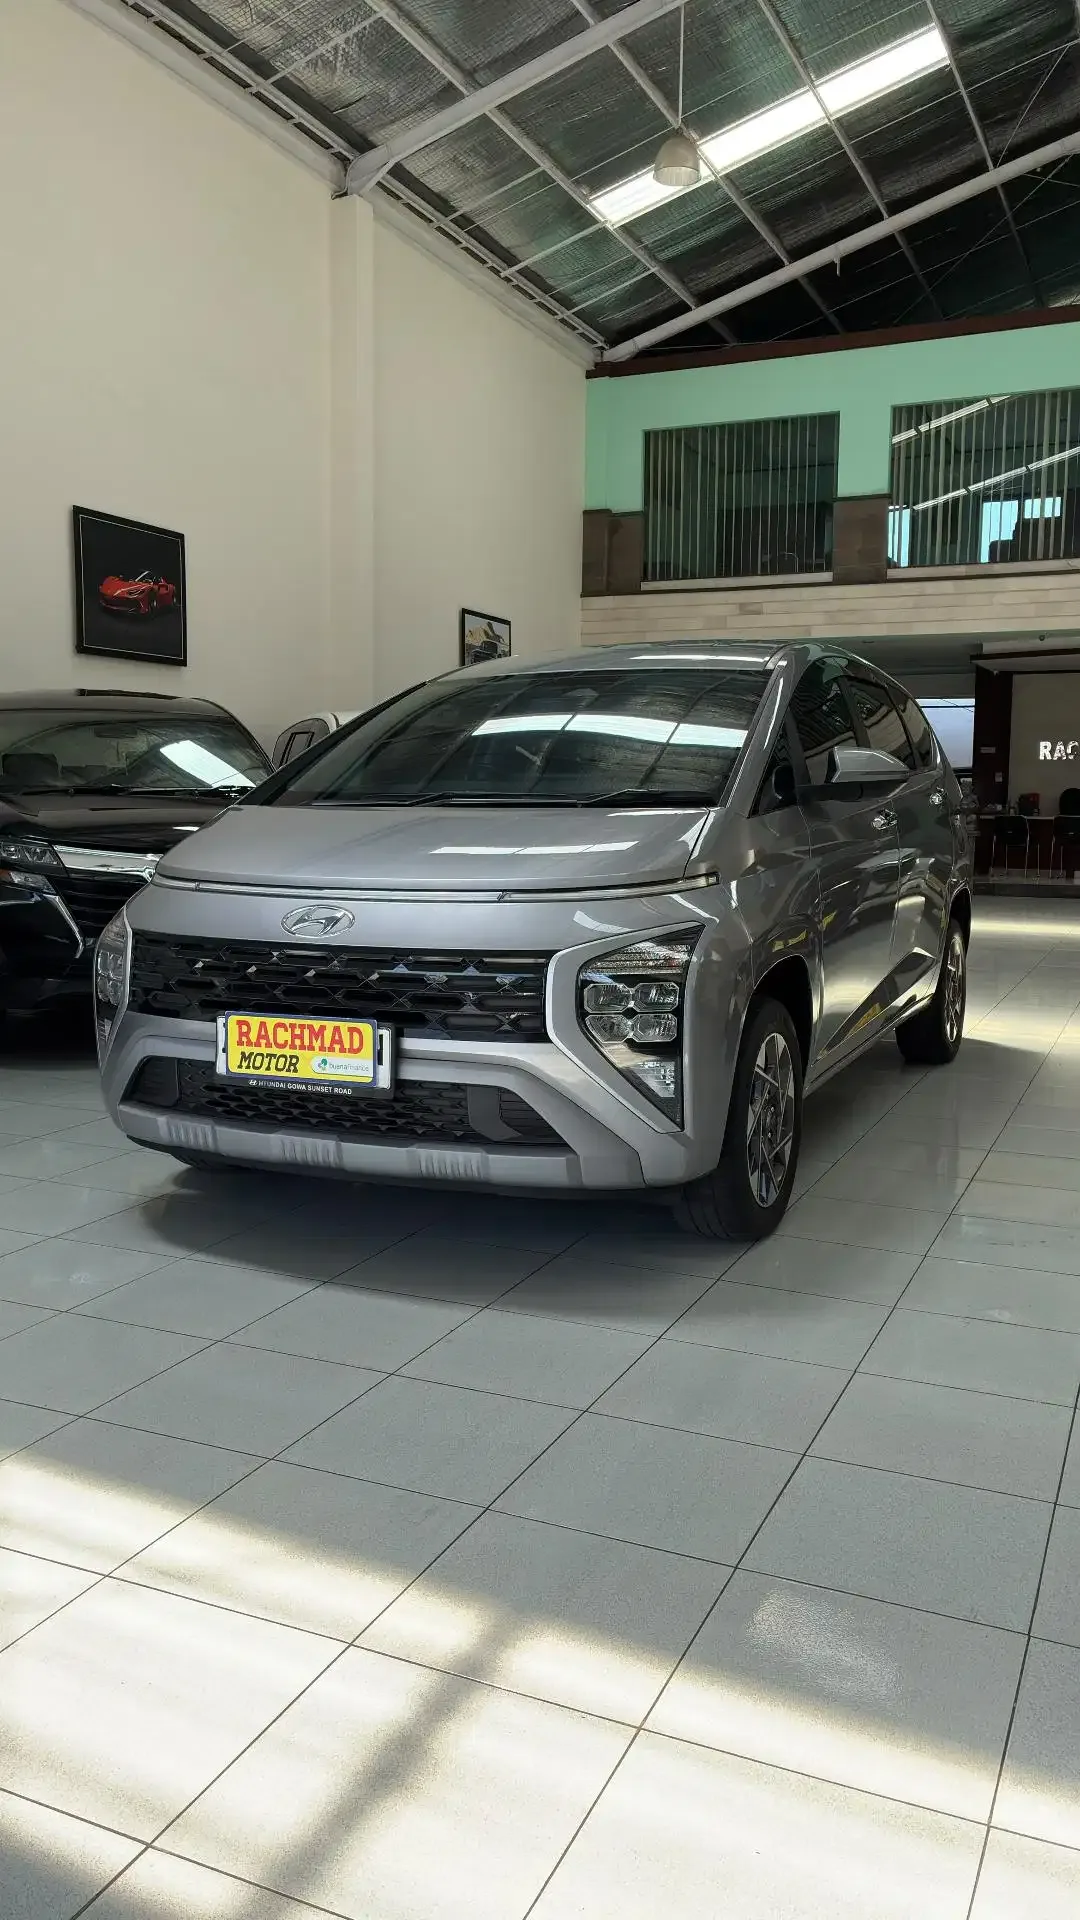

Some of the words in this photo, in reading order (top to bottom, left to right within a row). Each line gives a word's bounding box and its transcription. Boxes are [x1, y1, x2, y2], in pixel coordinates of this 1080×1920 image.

[235, 1019, 364, 1054] RACHMAD
[237, 1051, 300, 1073] MOTOR
[258, 1080, 286, 1088] HYUNDAI
[287, 1082, 306, 1091] GOWA
[307, 1084, 332, 1093] SUNSET
[333, 1087, 352, 1095] ROAD
